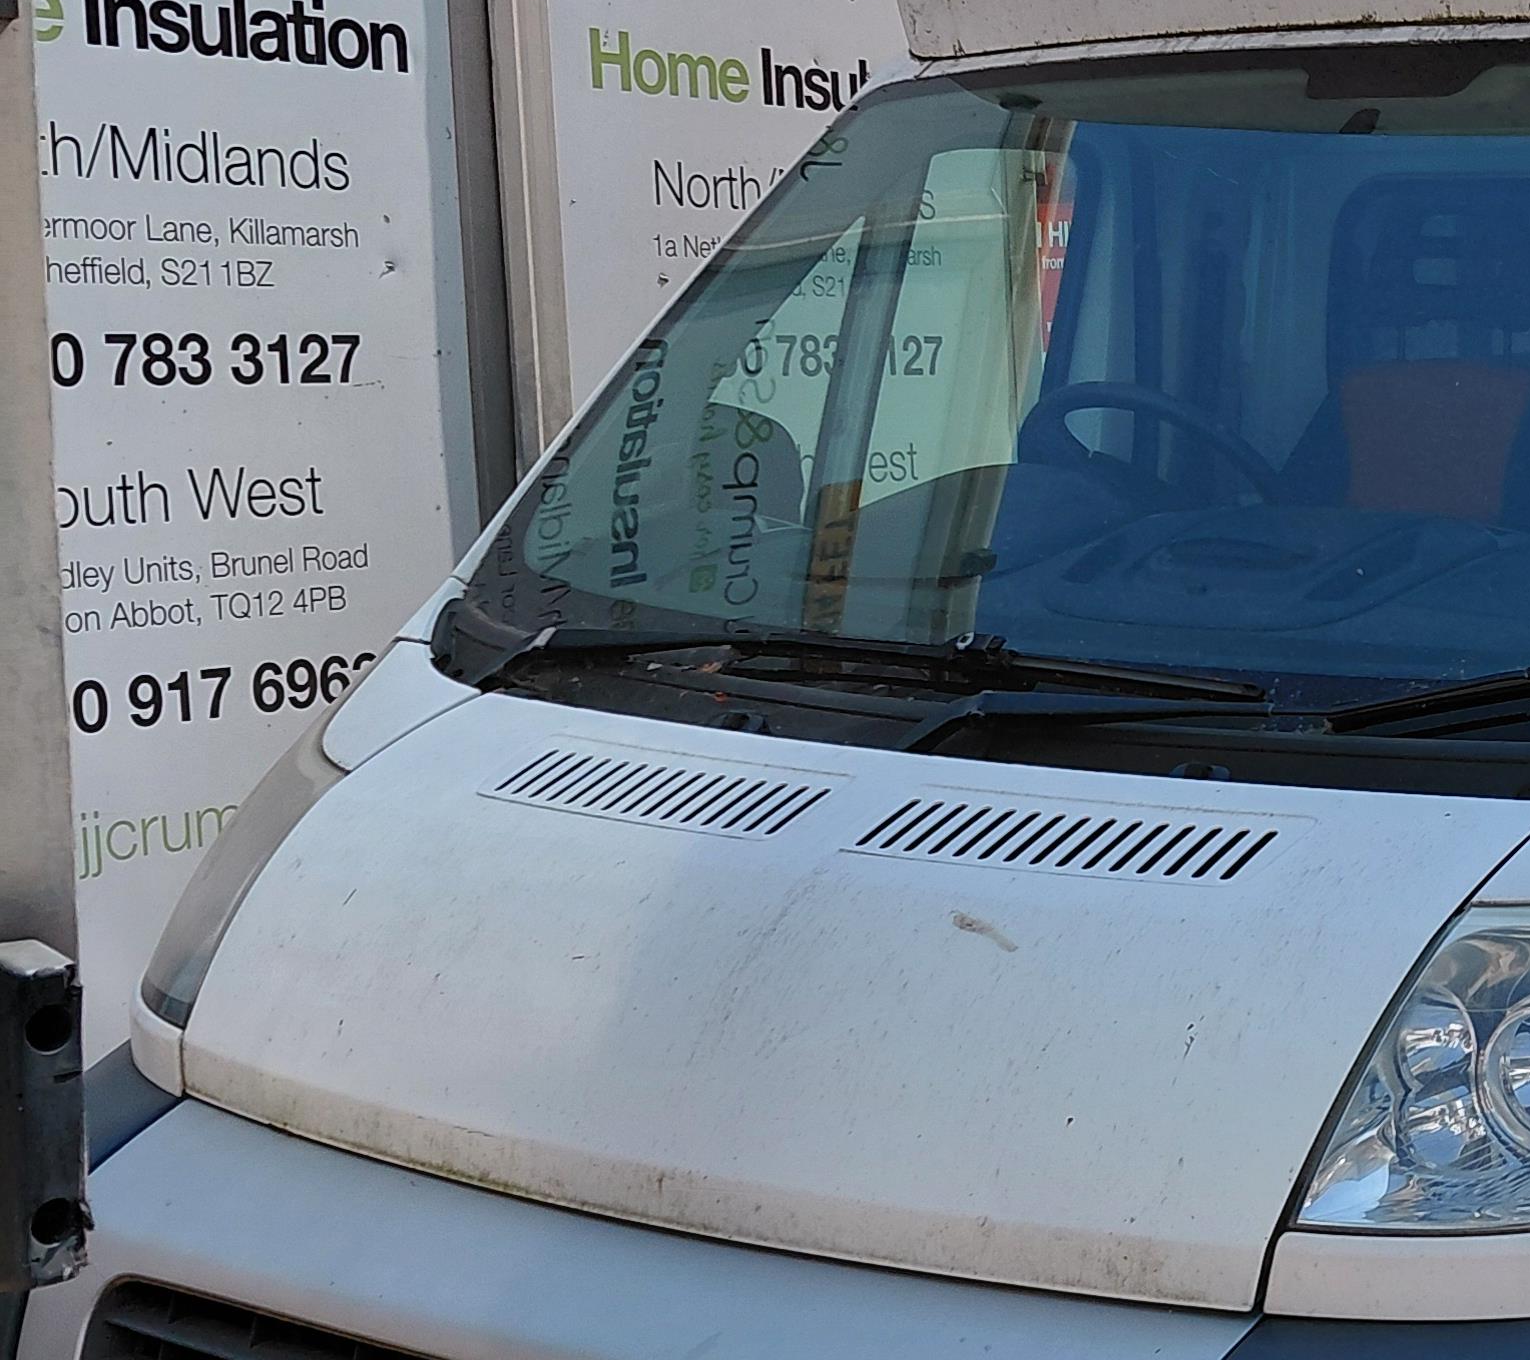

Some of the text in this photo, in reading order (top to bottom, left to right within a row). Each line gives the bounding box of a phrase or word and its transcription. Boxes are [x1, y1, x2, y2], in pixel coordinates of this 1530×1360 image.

[588, 25, 751, 106] Home
[41, 121, 351, 192] h/Midlands
[146, 215, 219, 245] Lane,
[229, 218, 360, 249] Killamarsh
[654, 235, 678, 257] 1a
[161, 259, 215, 288] S21
[220, 260, 275, 288] 1BZ
[104, 332, 212, 388] 783
[231, 332, 361, 387] 3127
[187, 466, 324, 521] West
[124, 555, 201, 585] Units,
[211, 547, 293, 578] Brunel
[303, 543, 369, 571] Road
[110, 598, 202, 630] Abbot,
[210, 590, 284, 620] TQ12
[293, 585, 347, 614] 4PB
[128, 666, 232, 727] 917
